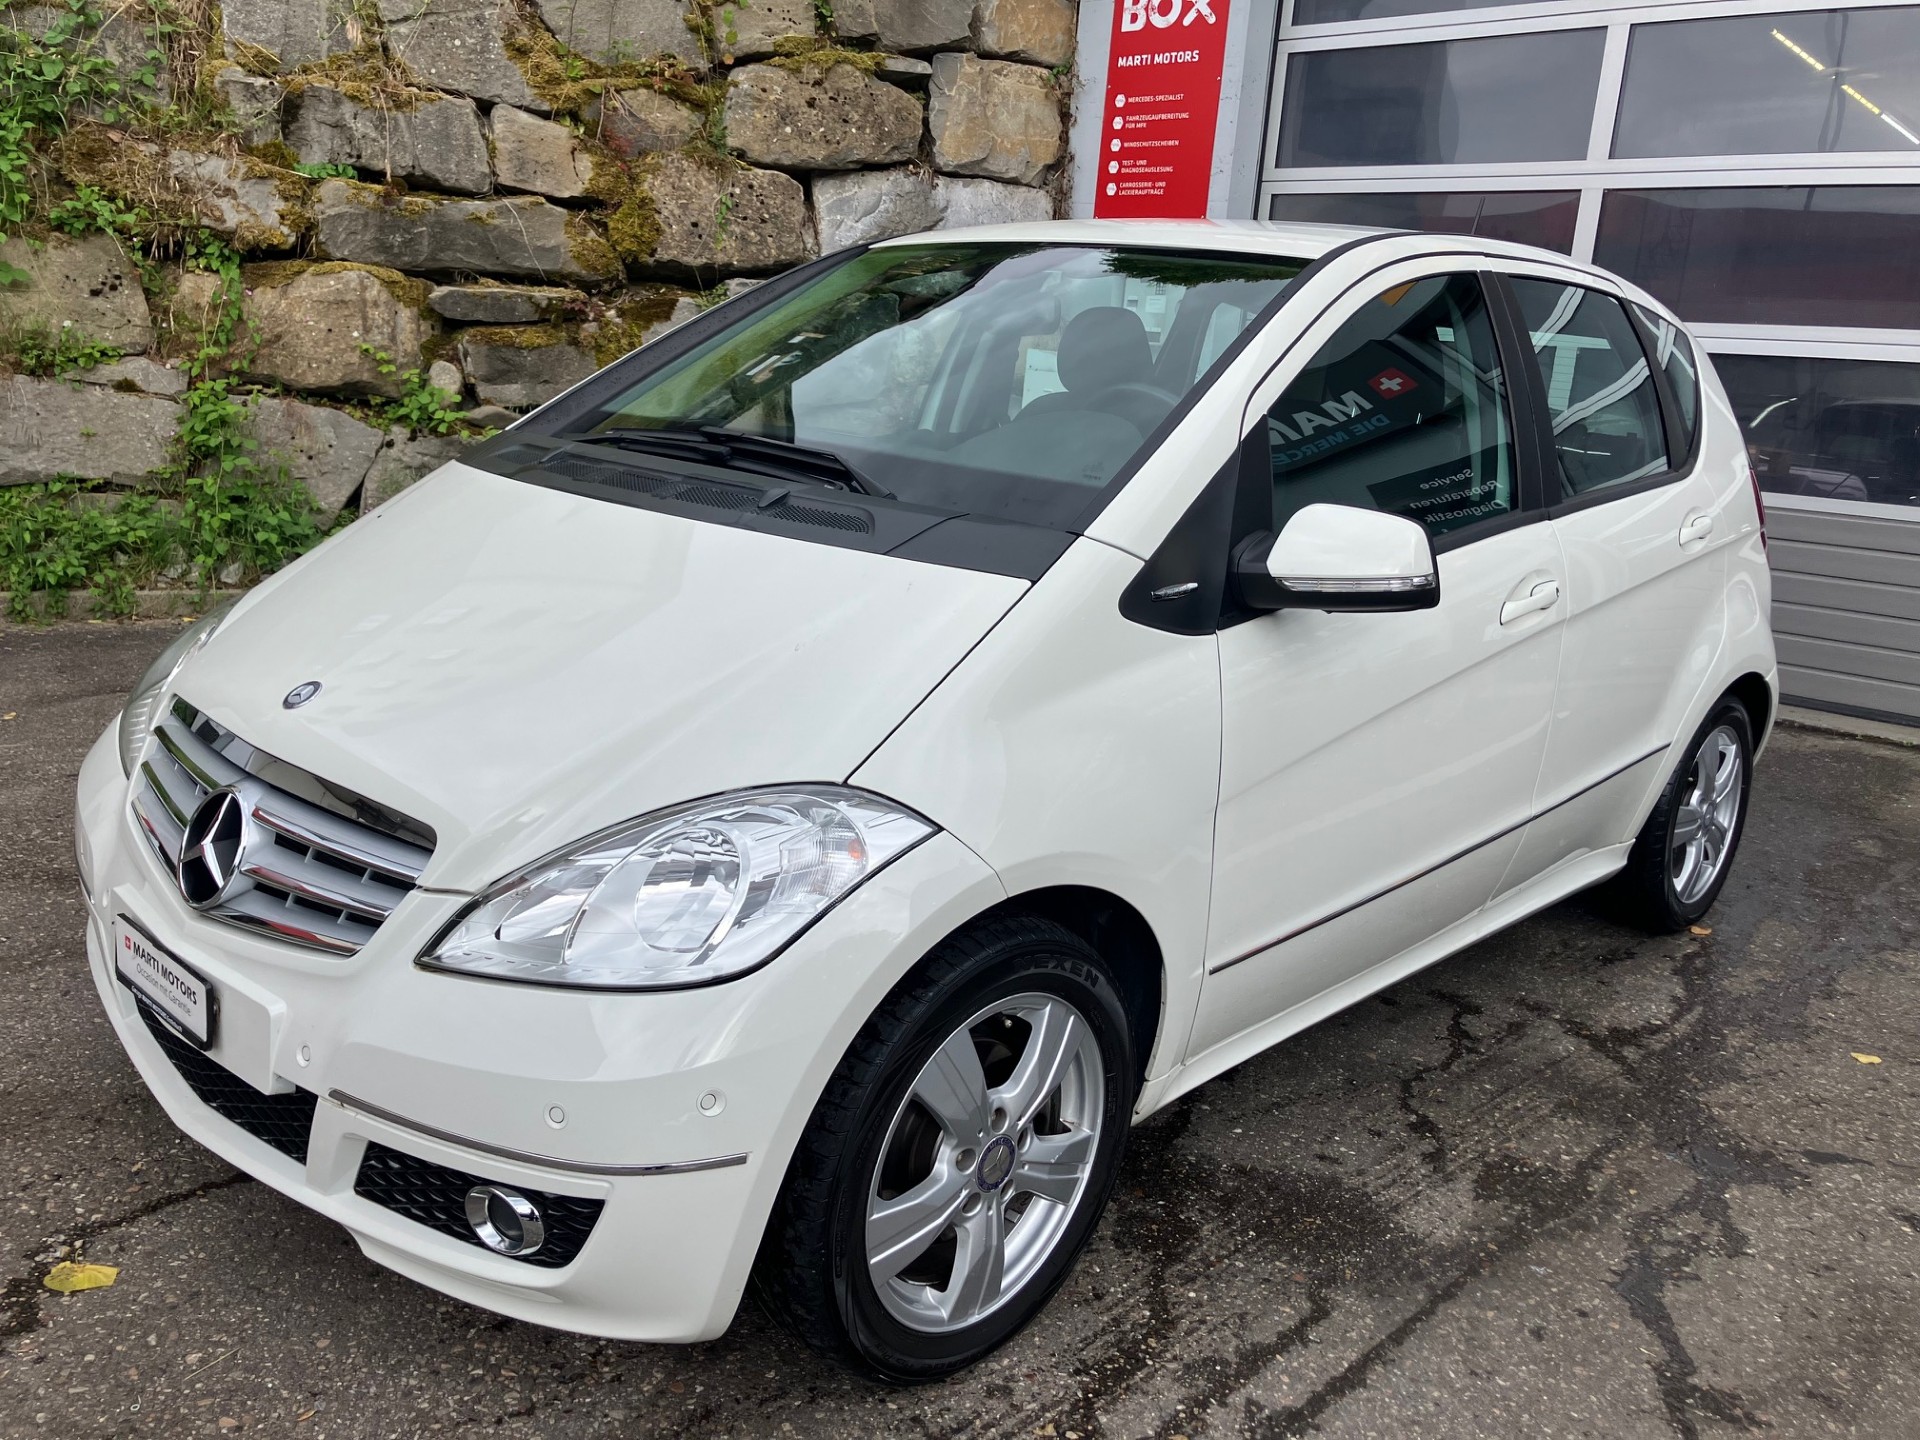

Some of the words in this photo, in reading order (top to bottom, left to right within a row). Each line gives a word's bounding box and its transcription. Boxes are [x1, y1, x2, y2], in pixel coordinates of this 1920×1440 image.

[1121, 0, 1216, 32] BOX
[1117, 54, 1151, 68] MARTI
[1154, 50, 1199, 65] MOTORS
[1128, 94, 1184, 103] MERCEDES-SPEZIALIST
[1126, 112, 1189, 121] FAHRZEUGAUFBEREITUNG
[1123, 140, 1179, 148] WINDSCHUTZSCHEIBEN
[1121, 166, 1173, 174] DIAGNOSEAUSLESUNG
[133, 941, 160, 974] MARTI
[161, 964, 197, 1006] MOTORS
